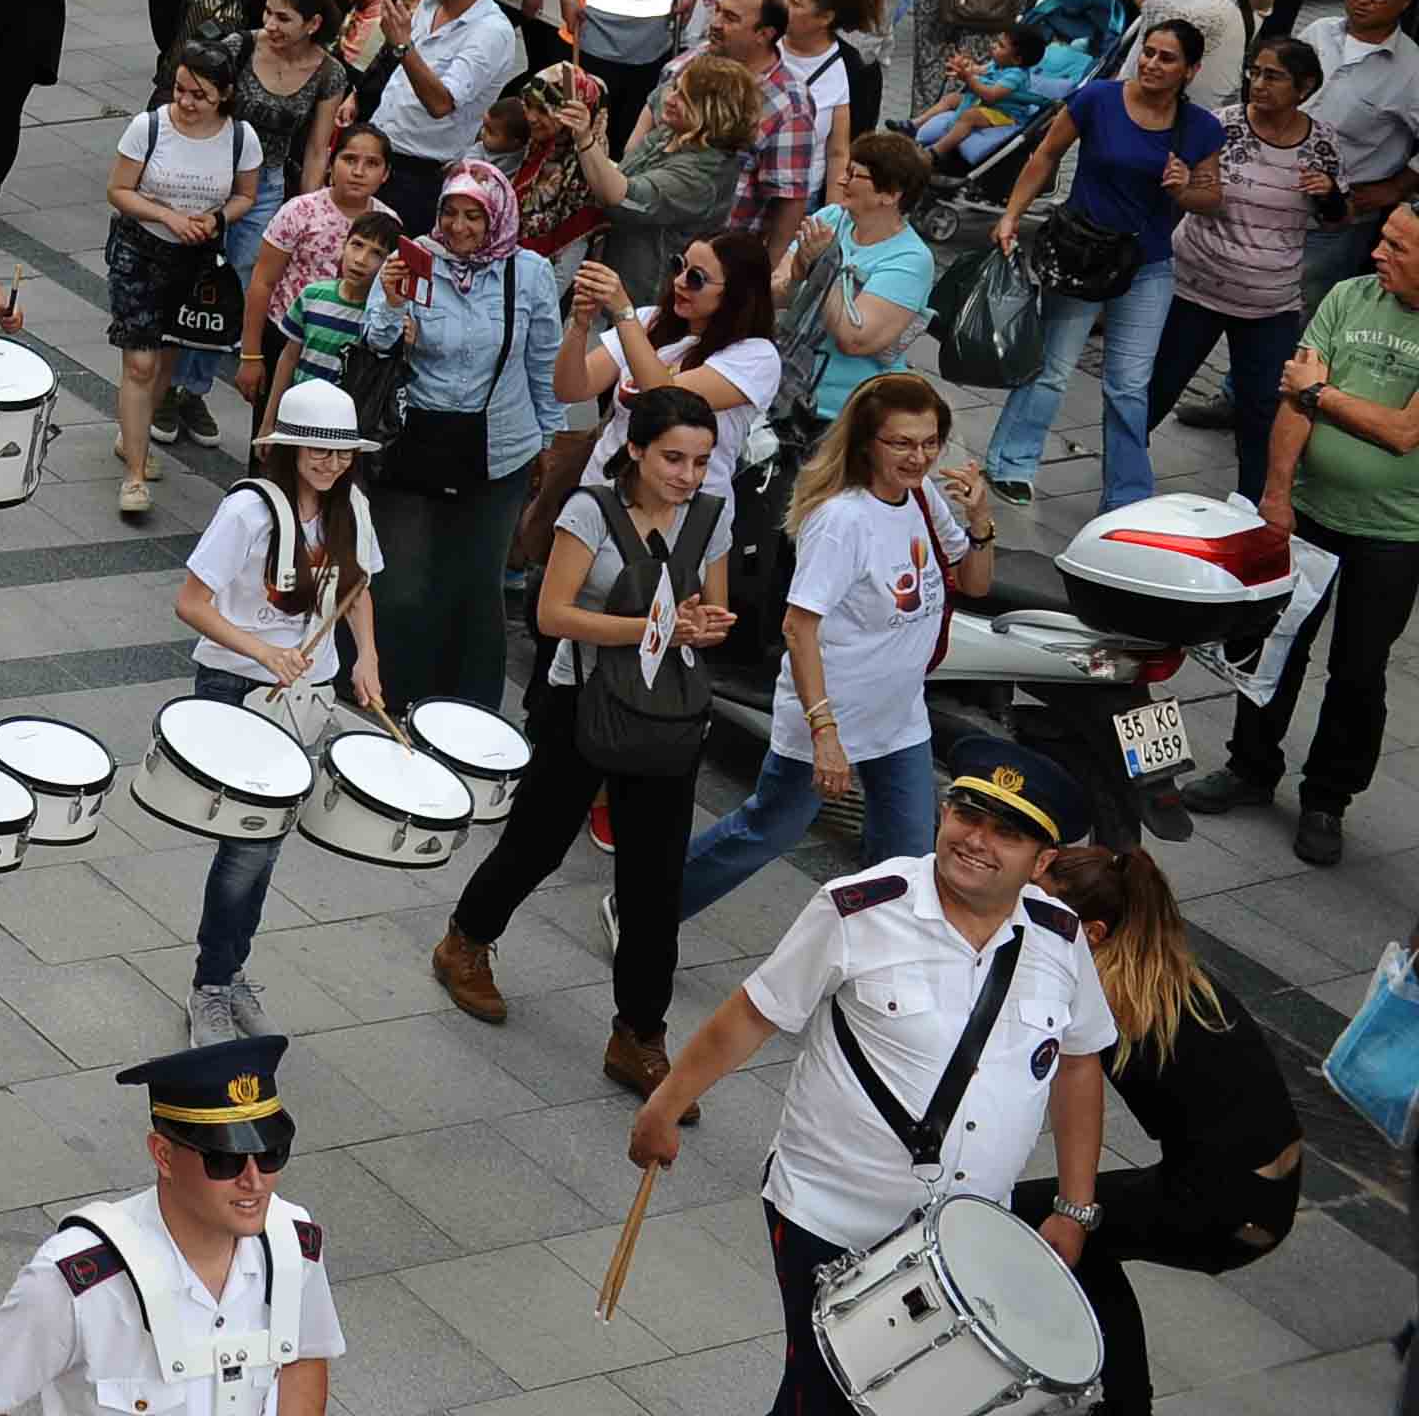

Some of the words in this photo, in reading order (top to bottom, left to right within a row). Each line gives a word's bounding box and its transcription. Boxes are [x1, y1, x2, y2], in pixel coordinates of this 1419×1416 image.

[177, 303, 224, 331] tena
[1121, 715, 1145, 740] 35
[1153, 704, 1179, 732] KC
[1143, 735, 1182, 764] 4359
